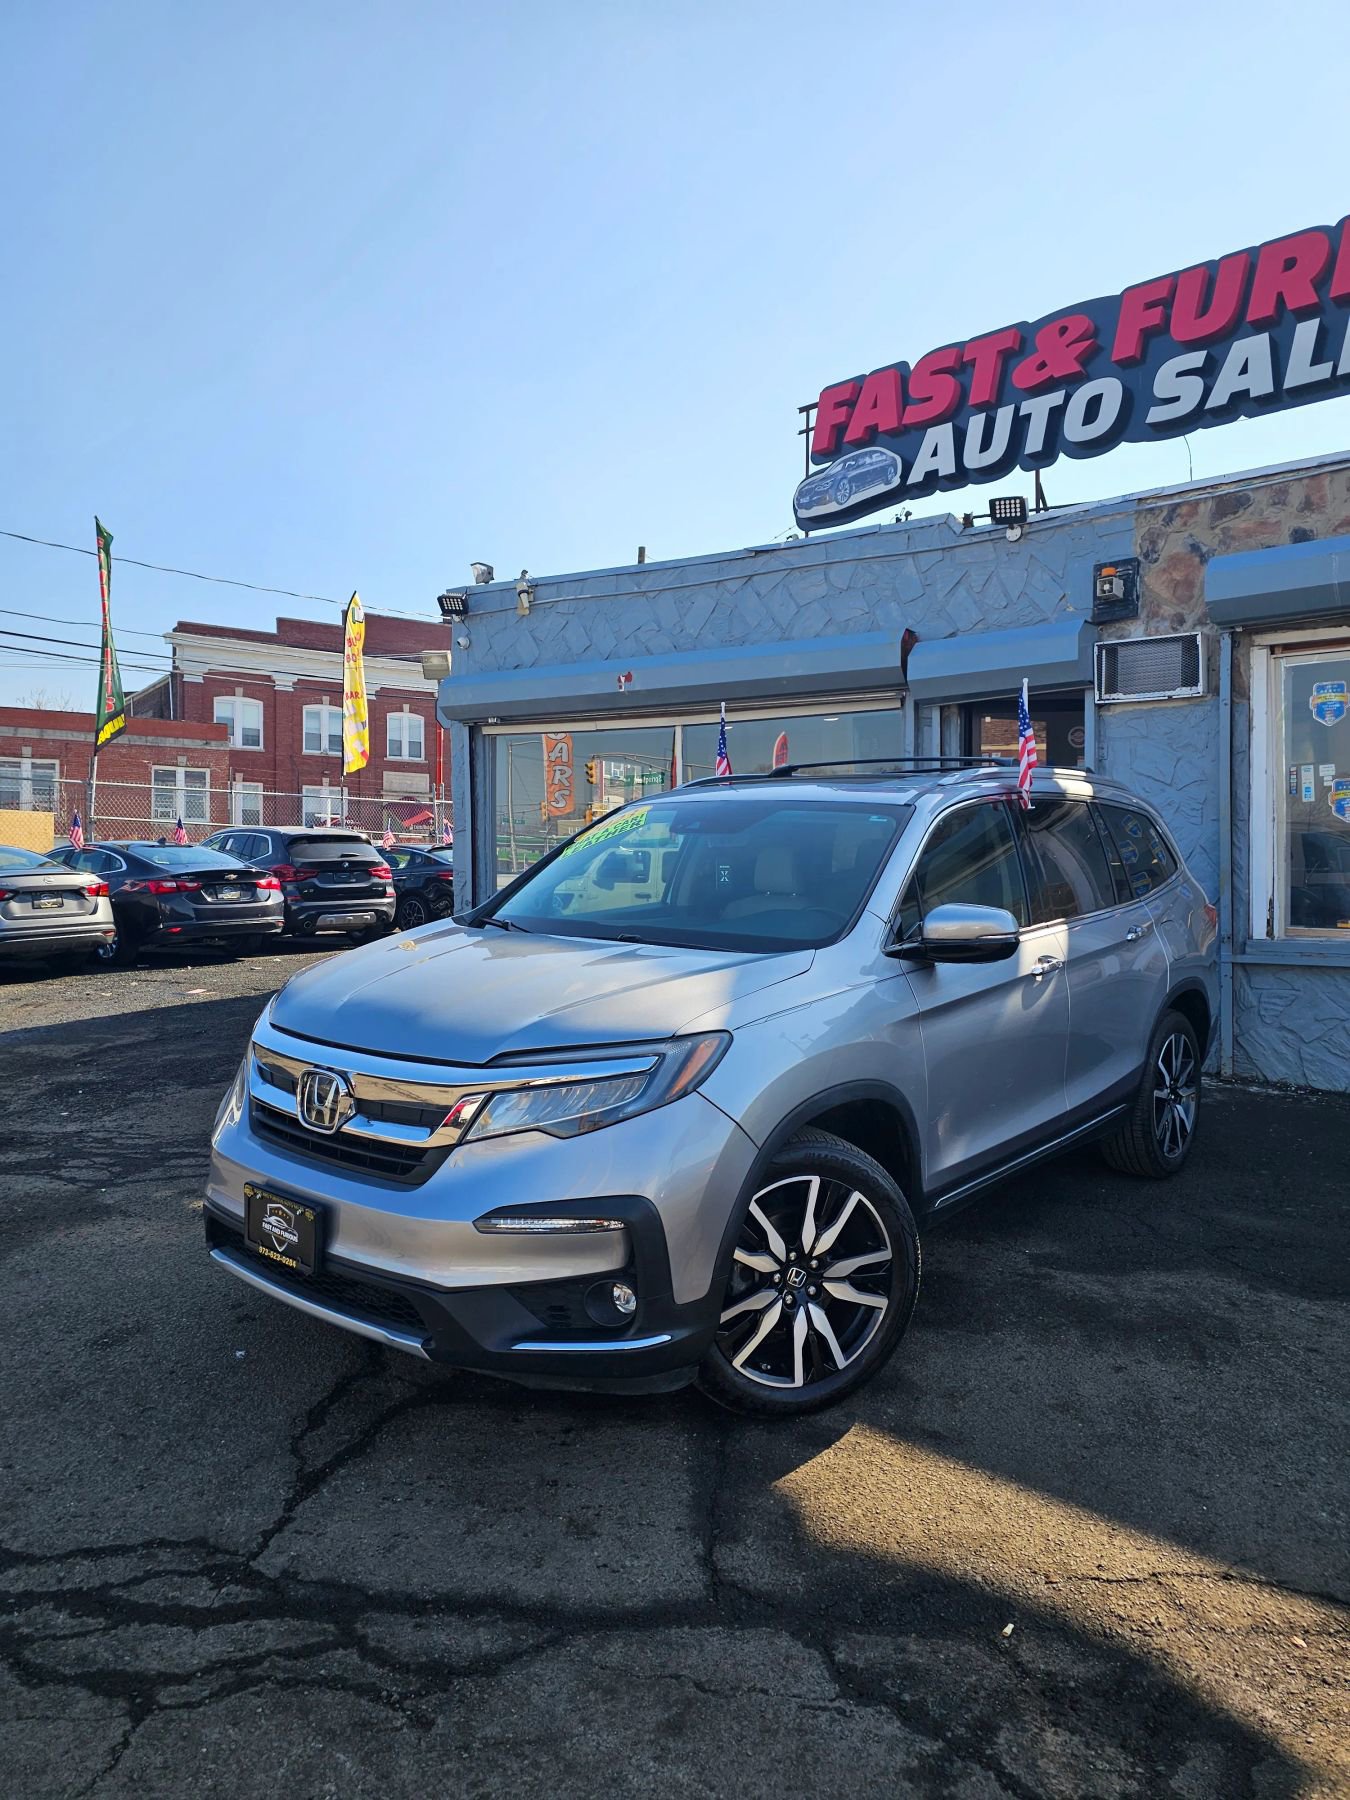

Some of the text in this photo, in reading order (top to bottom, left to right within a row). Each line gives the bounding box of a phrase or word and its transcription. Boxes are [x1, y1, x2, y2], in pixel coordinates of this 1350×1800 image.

[811, 327, 1021, 454] FAST
[1011, 314, 1099, 390] &
[906, 314, 1350, 485] AUTO SAL
